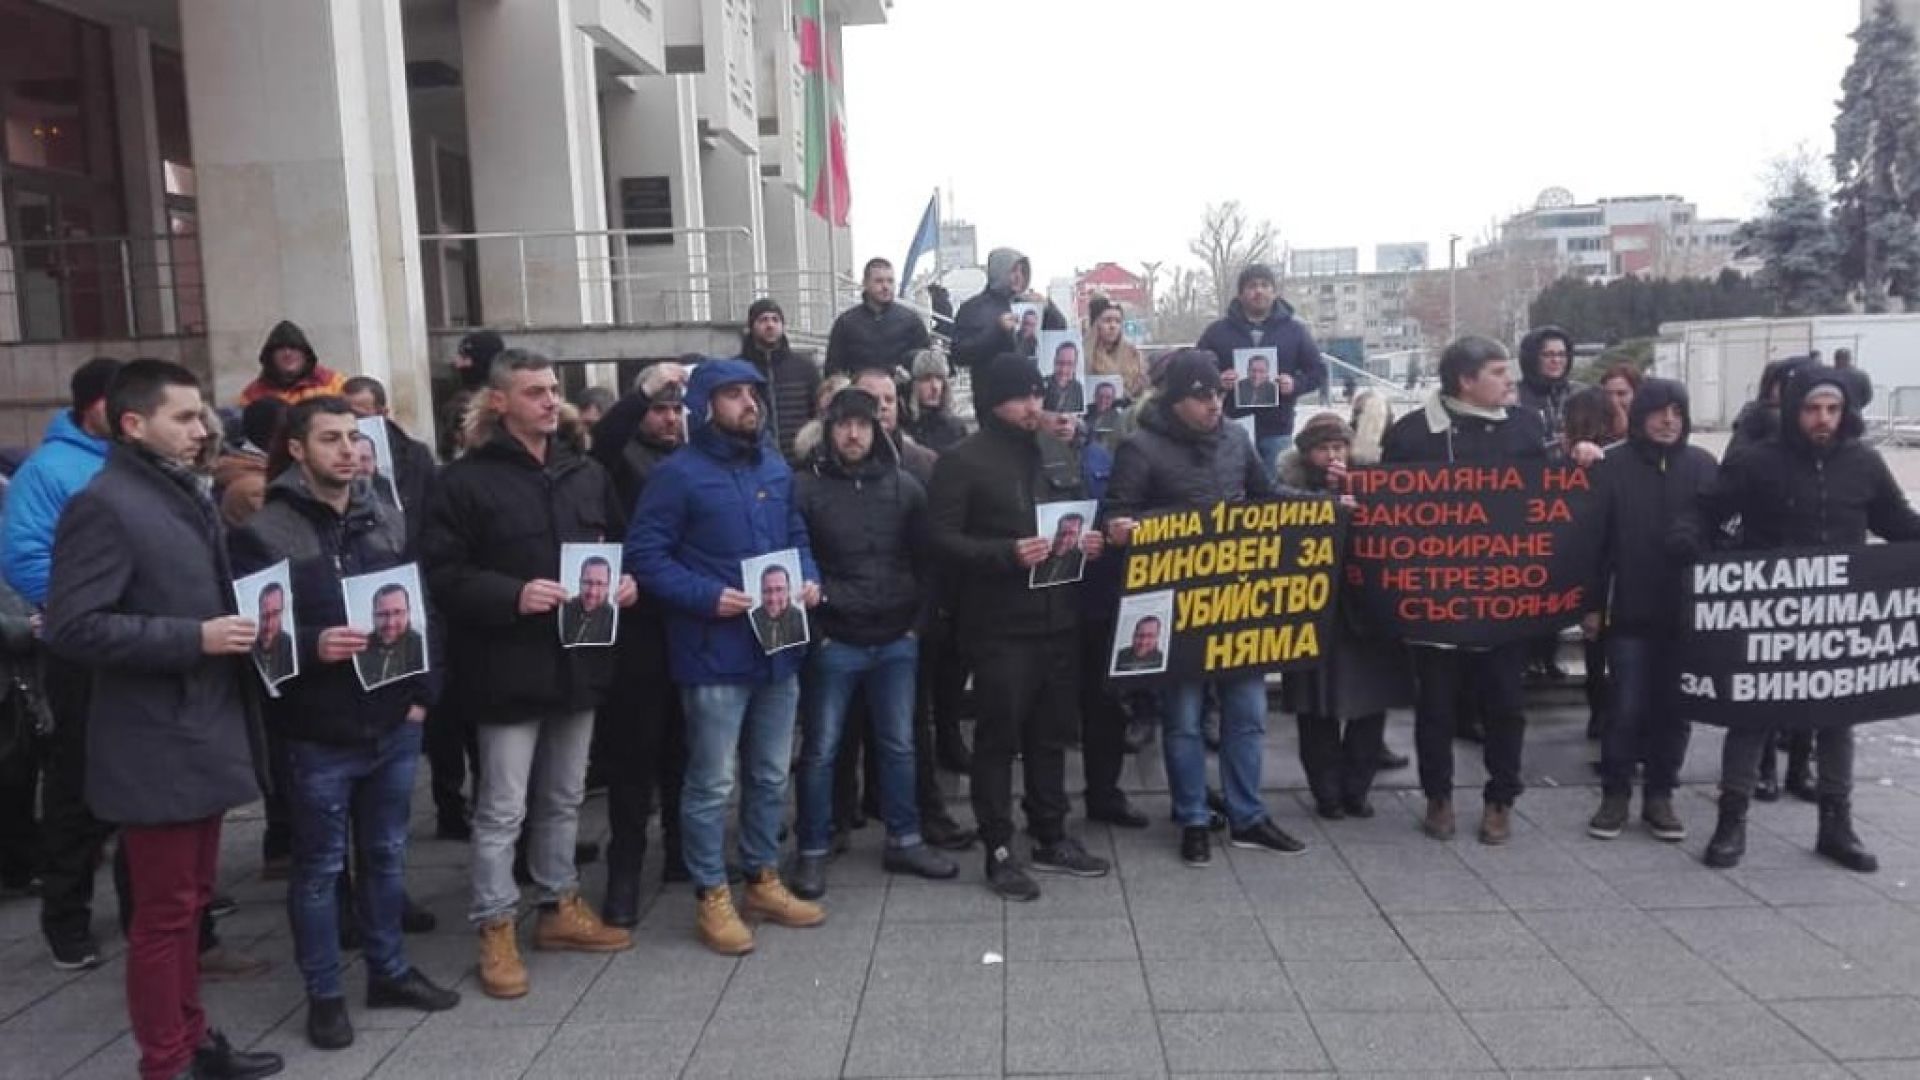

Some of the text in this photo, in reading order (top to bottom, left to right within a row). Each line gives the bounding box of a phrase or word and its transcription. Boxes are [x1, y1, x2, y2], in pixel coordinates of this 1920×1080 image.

[1345, 466, 1590, 494] ПРОМЯНА НА
[1132, 510, 1202, 546] МИНА
[1352, 498, 1572, 526] ЗАКОНА ЗА
[1126, 535, 1335, 589] ВИНОВЕН ЗА
[1355, 532, 1555, 559] ШОФИРАНЕ
[1382, 565, 1549, 591] НЕТРЕЗВО
[1694, 554, 1850, 593] ИСКАМЕ
[1175, 573, 1330, 631] УБИЙСТВО
[1400, 586, 1585, 620] СЪСТОЯНИЕ
[1205, 622, 1320, 671] НЯМА
[1747, 620, 1919, 663] ПРИСЪДА
[1680, 672, 1717, 699] ЗА
